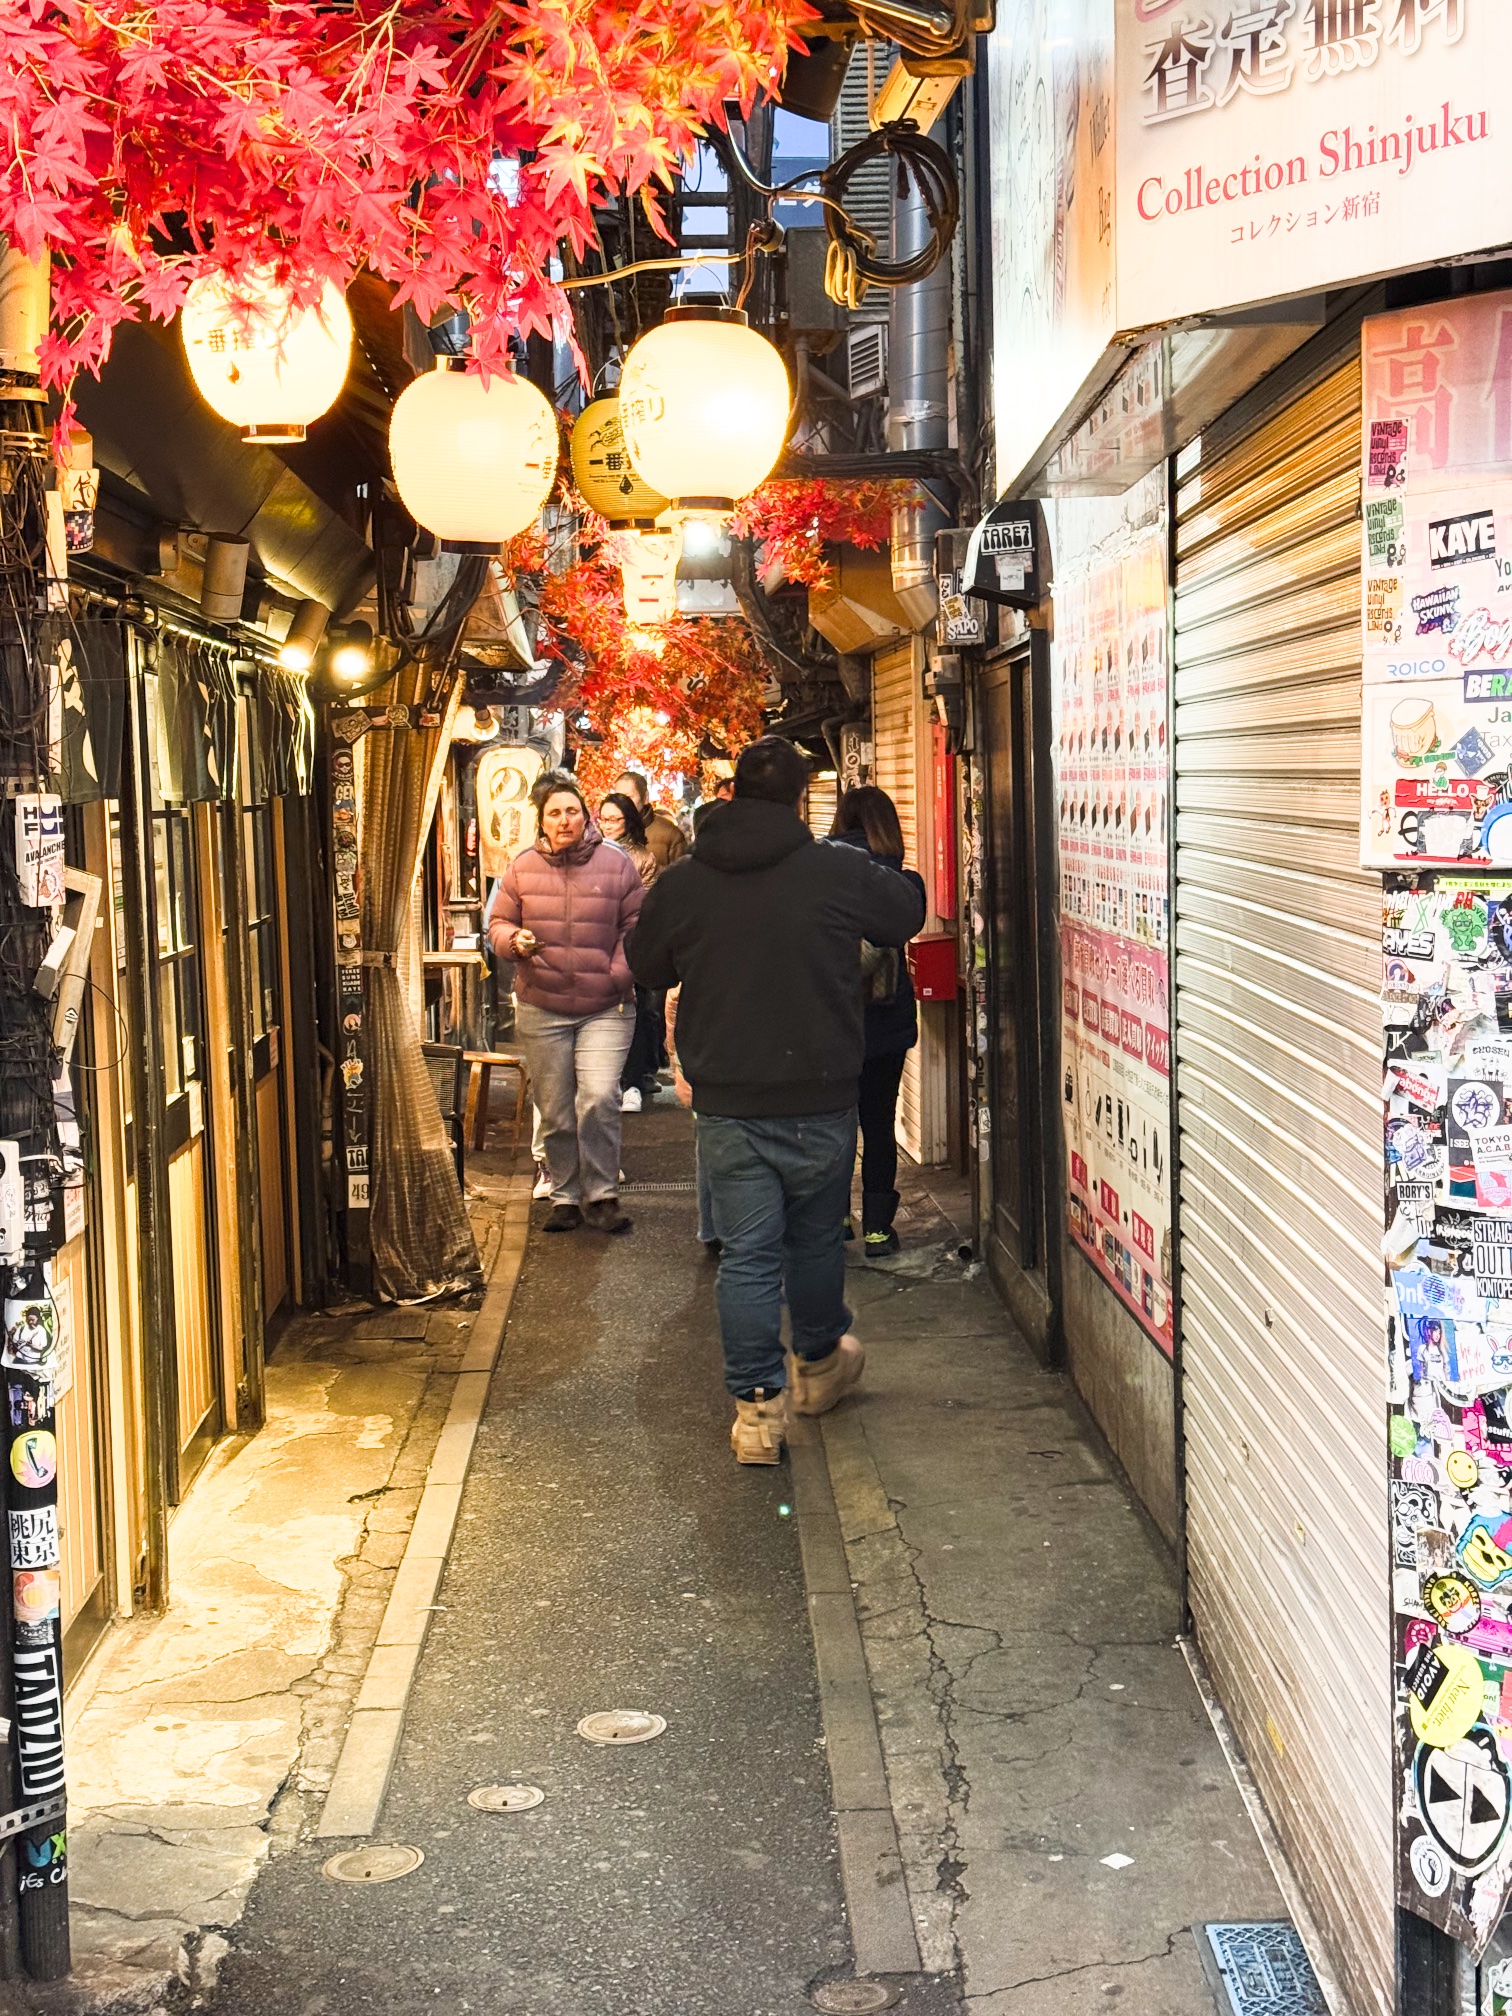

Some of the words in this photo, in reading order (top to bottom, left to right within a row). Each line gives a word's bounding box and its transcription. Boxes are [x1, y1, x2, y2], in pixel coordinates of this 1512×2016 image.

[1137, 154, 1305, 222] Collection
[1318, 101, 1489, 175] Shinjuku
[1230, 191, 1381, 244] コレクション新宿
[1429, 516, 1495, 559] KAYE
[1420, 602, 1455, 624] SKUNK
[1387, 659, 1446, 677] ROICO
[25, 840, 65, 864] AVALANCHE
[1475, 1135, 1511, 1145] TOKYO
[1398, 1183, 1431, 1200] RORY'S
[10, 1511, 54, 1540] 桃尻
[12, 1538, 56, 1565] 東京
[1423, 1650, 1434, 1664] THE
[1417, 1655, 1441, 1701] AVOID
[1448, 1678, 1470, 1705] Nett
